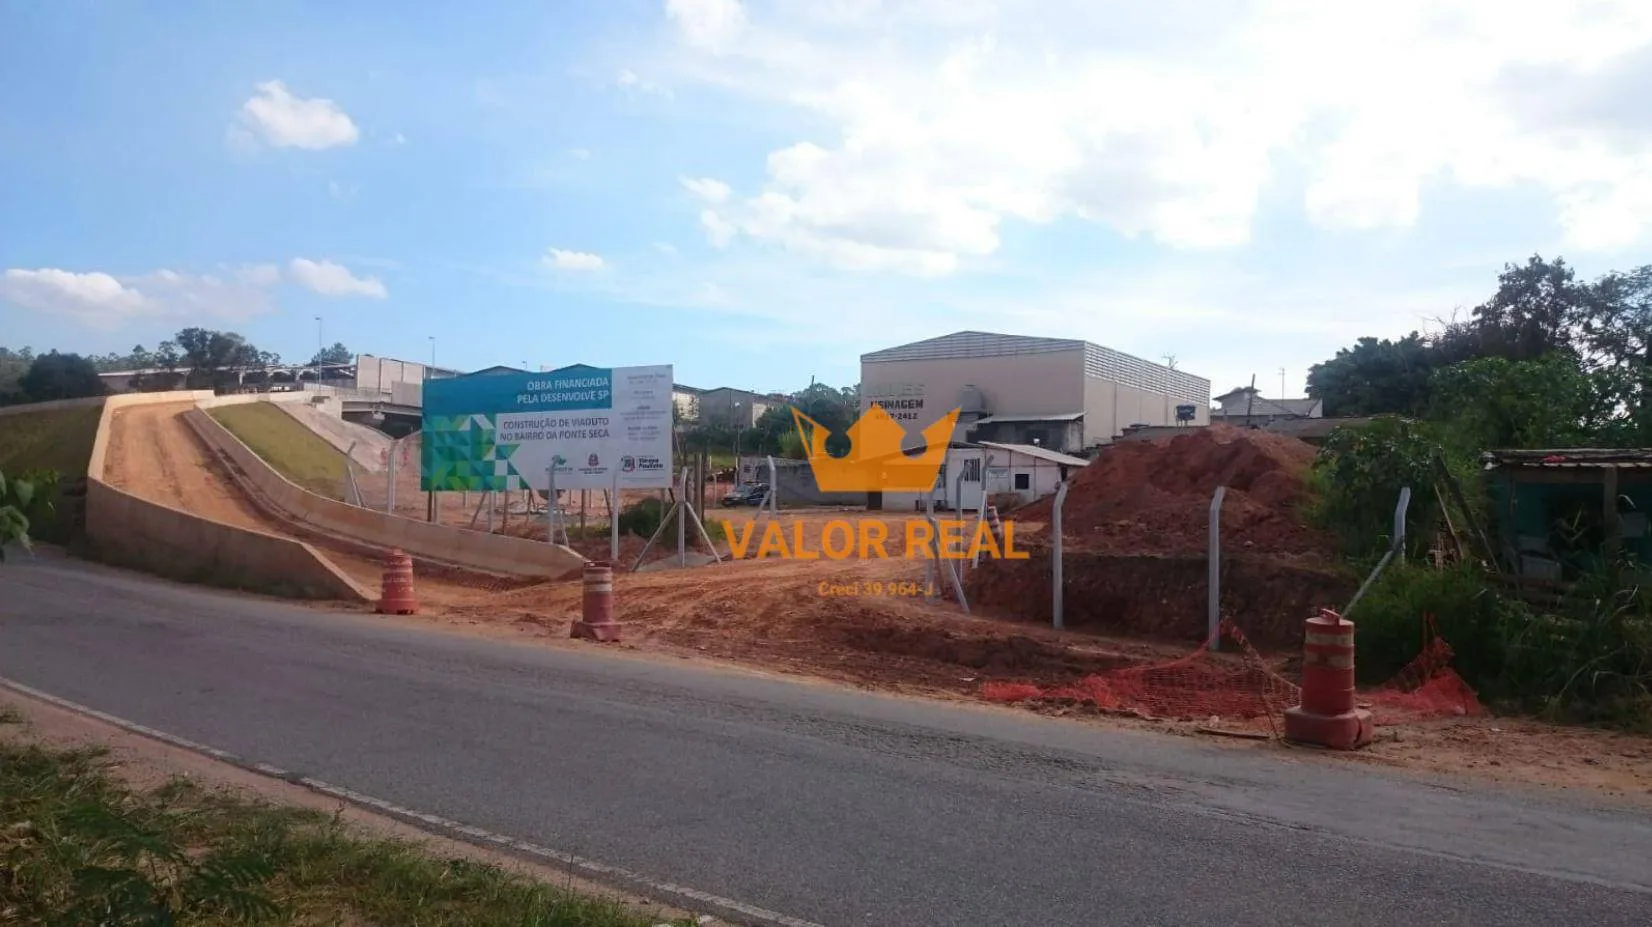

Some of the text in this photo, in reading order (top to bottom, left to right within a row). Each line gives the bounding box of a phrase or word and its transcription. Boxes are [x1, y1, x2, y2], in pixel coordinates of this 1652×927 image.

[527, 377, 609, 391] OBRA FINANCIADA
[517, 389, 609, 404] PELA DESENVOLVE SP
[503, 417, 609, 430] CONSTRUÇÃO DE VIADUTO
[500, 433, 513, 441] NO
[514, 431, 543, 441] BAIRRO
[588, 428, 610, 438] SECA
